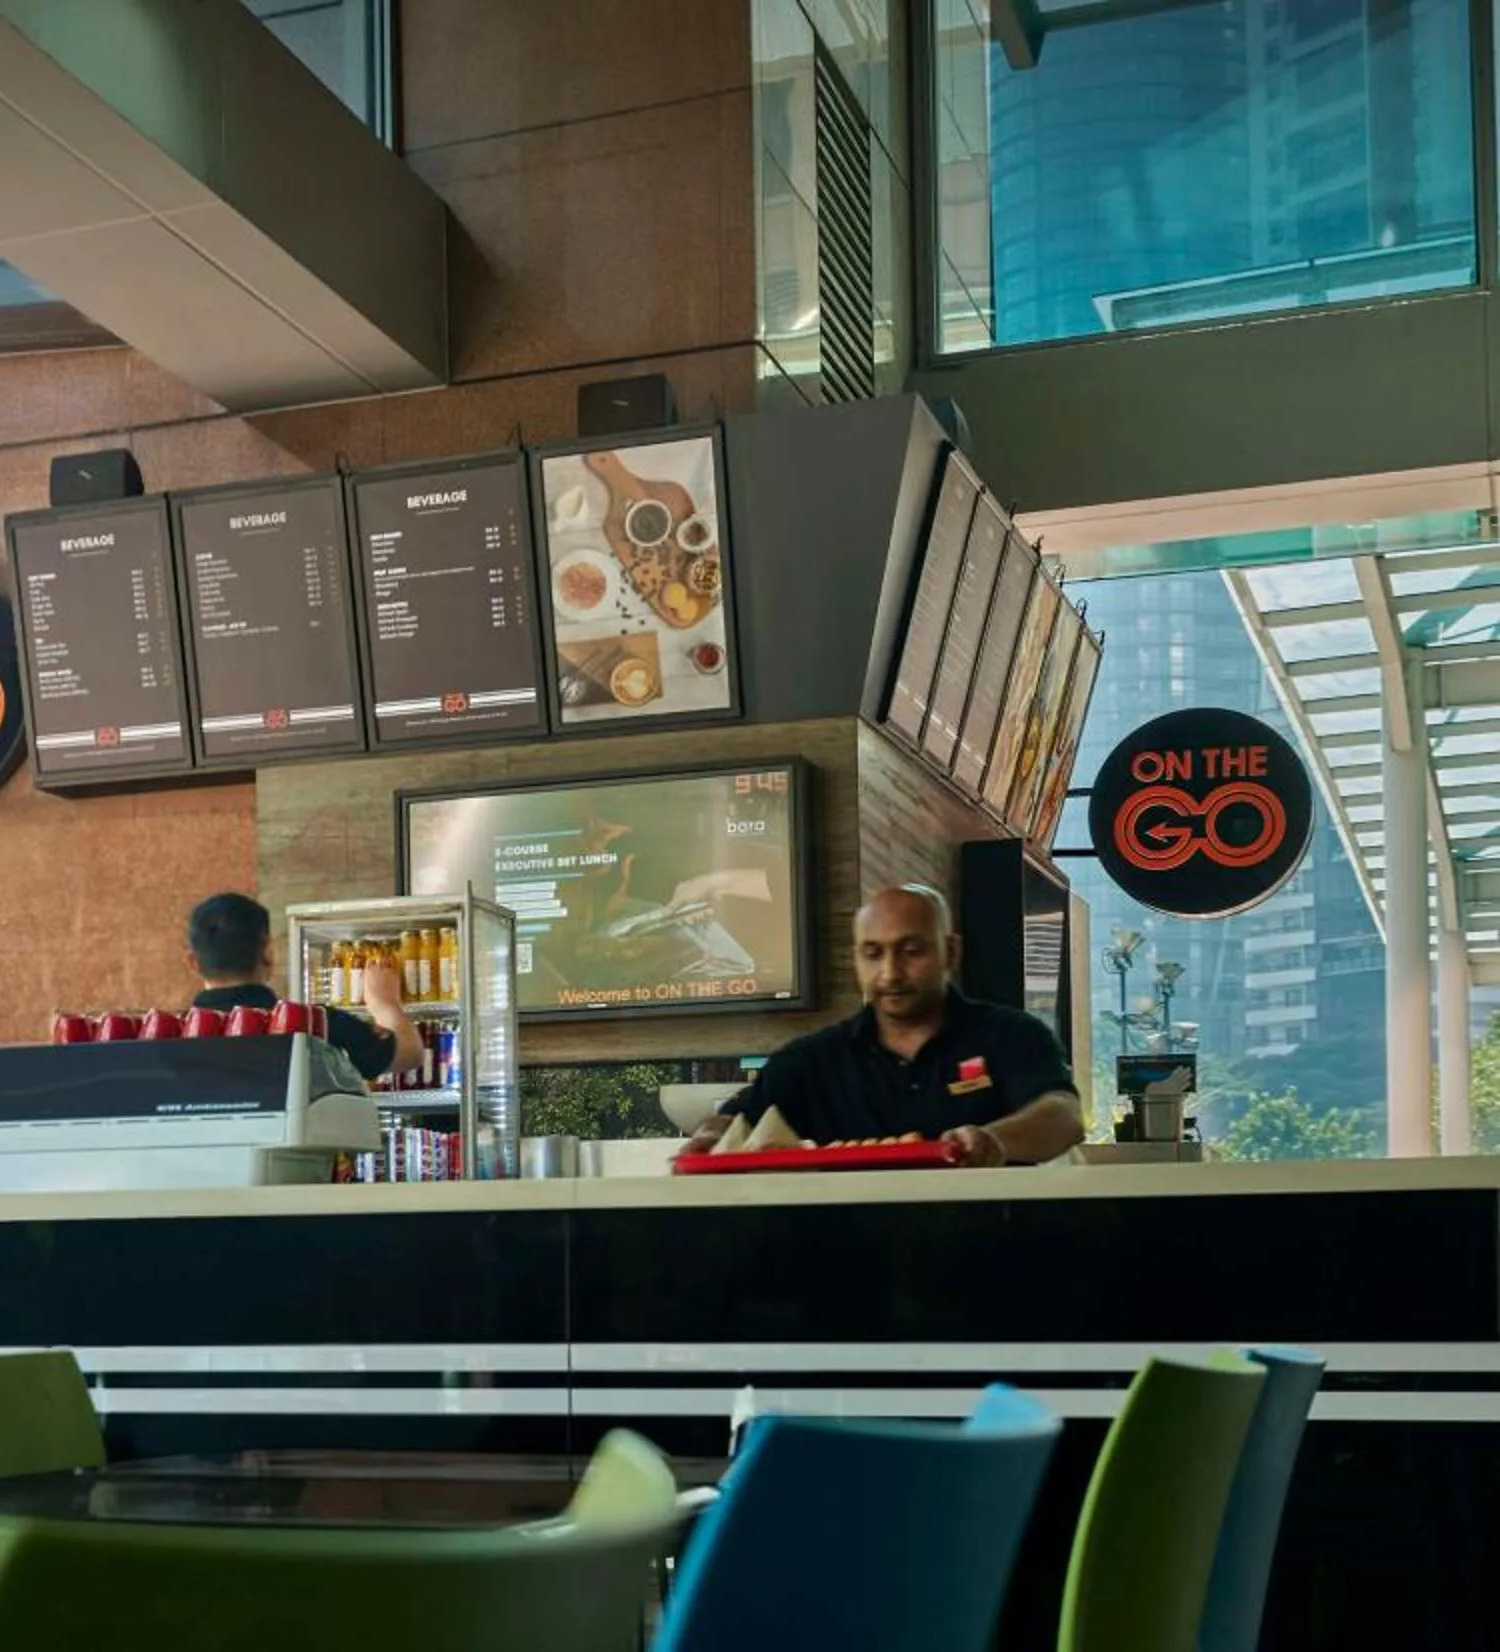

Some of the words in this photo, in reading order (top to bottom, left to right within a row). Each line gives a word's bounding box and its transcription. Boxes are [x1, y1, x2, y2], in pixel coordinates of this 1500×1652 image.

[407, 490, 469, 508] BEVERAGE
[229, 511, 287, 529] BEVERAGE
[60, 534, 115, 552] BEVERAGE
[1131, 750, 1193, 783] ON
[1202, 745, 1268, 778] THE
[1113, 781, 1287, 872] GO
[494, 858, 555, 873] EXECUTIVE
[557, 857, 577, 868] SET
[579, 853, 618, 866] LUNCH
[558, 988, 631, 1006] Welcome
[635, 986, 651, 1001] to
[655, 983, 683, 999] ON
[689, 980, 724, 996] THE
[727, 979, 758, 995] GO
